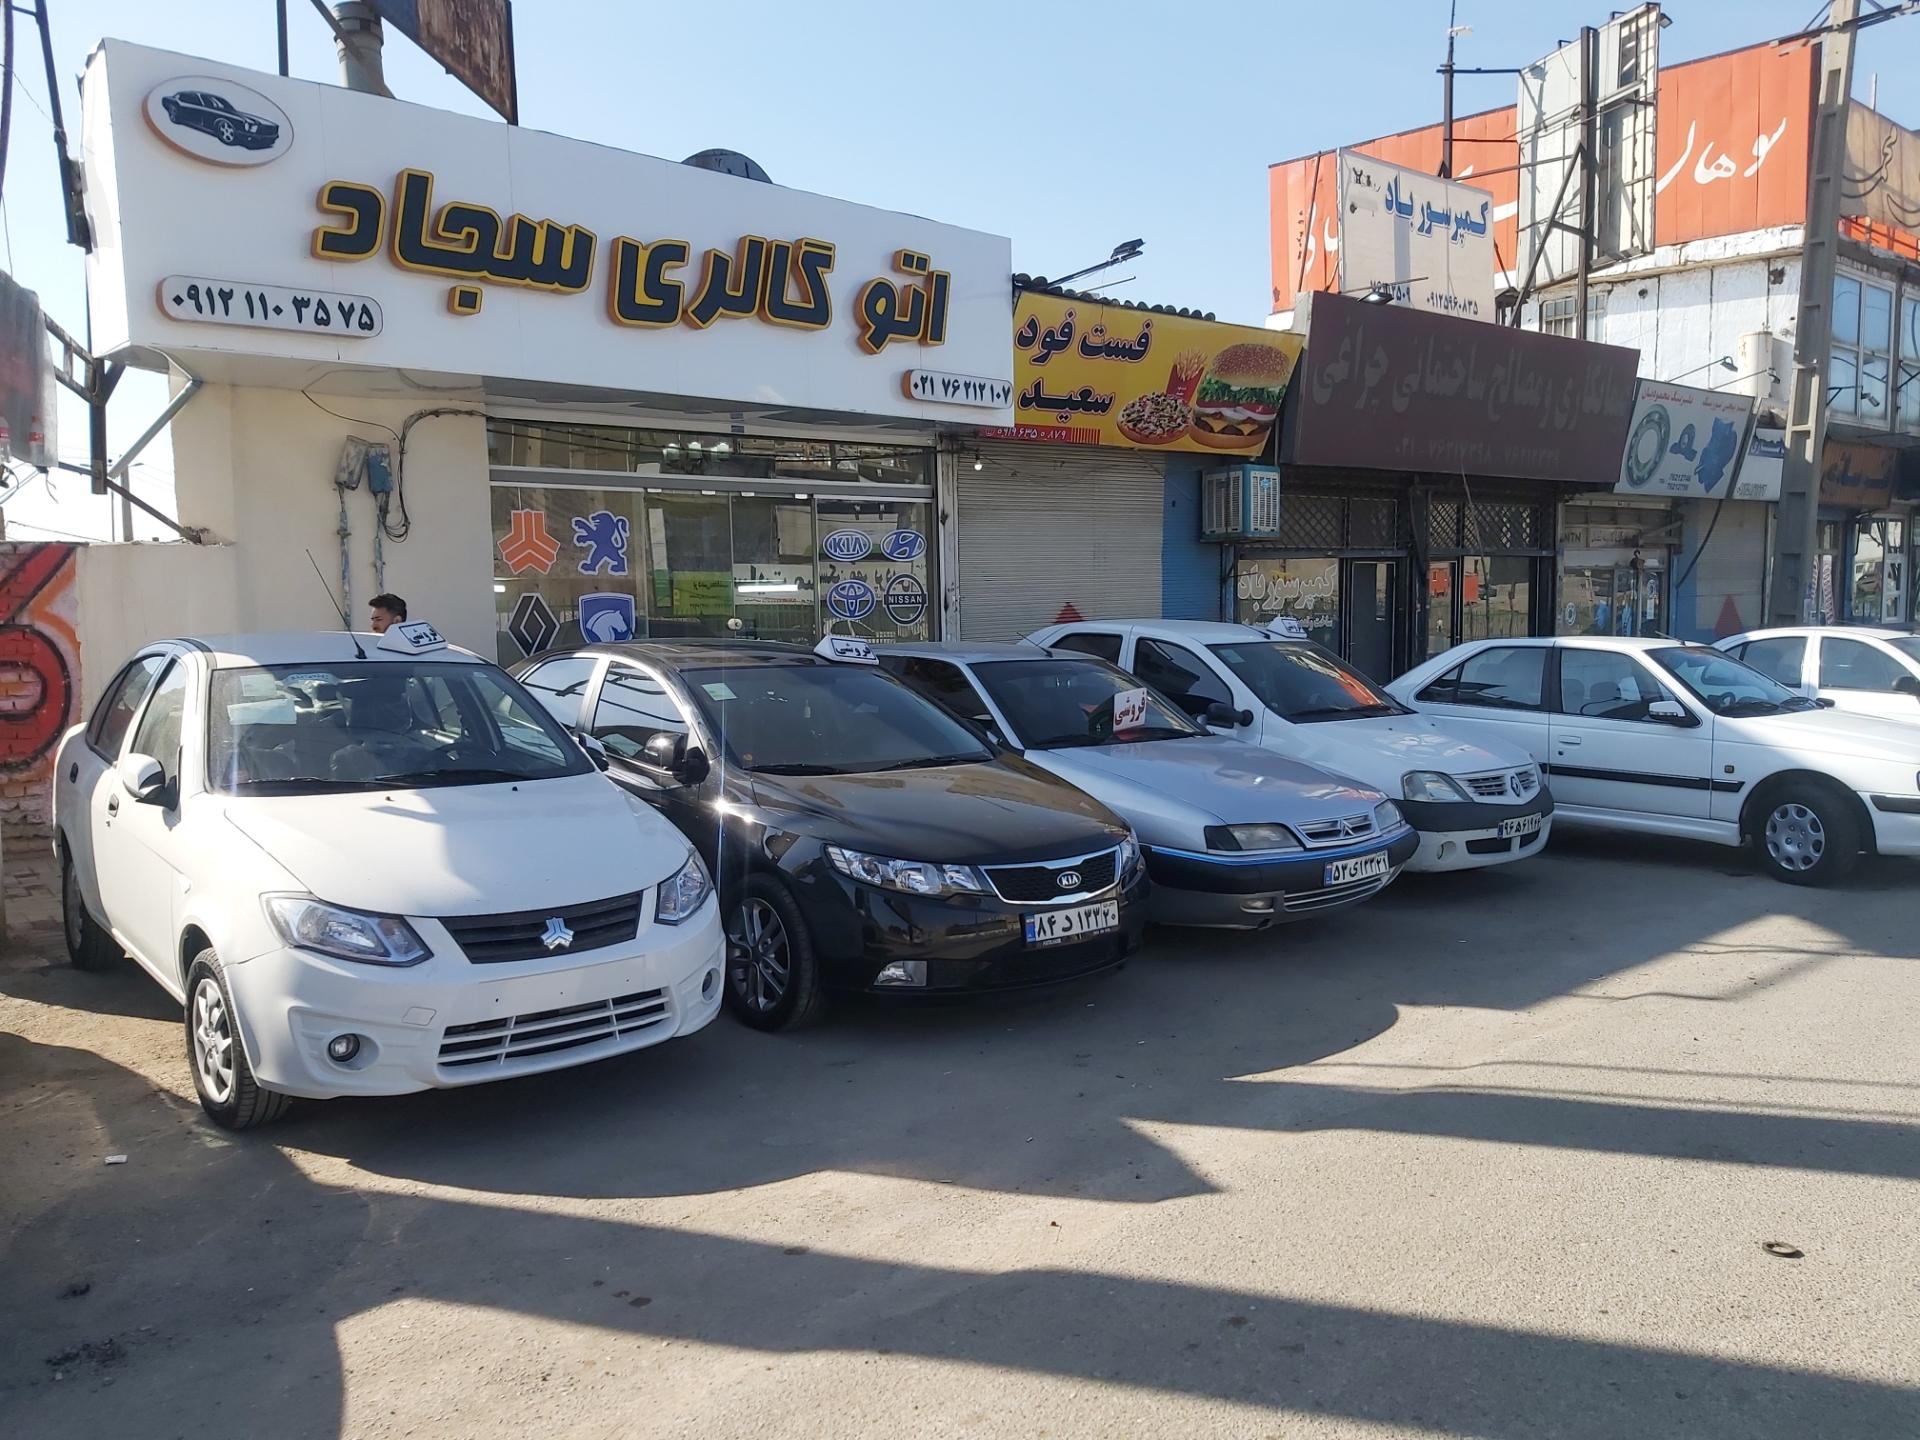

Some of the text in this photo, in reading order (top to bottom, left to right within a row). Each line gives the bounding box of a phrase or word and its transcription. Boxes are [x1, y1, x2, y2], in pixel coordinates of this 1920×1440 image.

[1385, 174, 1414, 231] باد
[1417, 200, 1489, 246] کمپرسور
[312, 168, 951, 354] اتو گالری سجاد
[172, 284, 233, 317] ۰۹۱۲
[245, 291, 285, 320] ۱۱۰
[1015, 308, 1152, 365] فست فود
[913, 375, 934, 396] ۰۲۱
[1312, 317, 1389, 415] چراغی
[1391, 334, 1485, 413] ساختمانی
[1018, 378, 1115, 423] سعید
[832, 536, 864, 554] KIA
[888, 594, 923, 604] NISSAN
[1237, 562, 1338, 612] کمپرسور باد
[409, 625, 437, 645] فروشی
[836, 643, 870, 657] فروشی
[1115, 691, 1146, 725] فروشی
[1061, 875, 1078, 886] KIA
